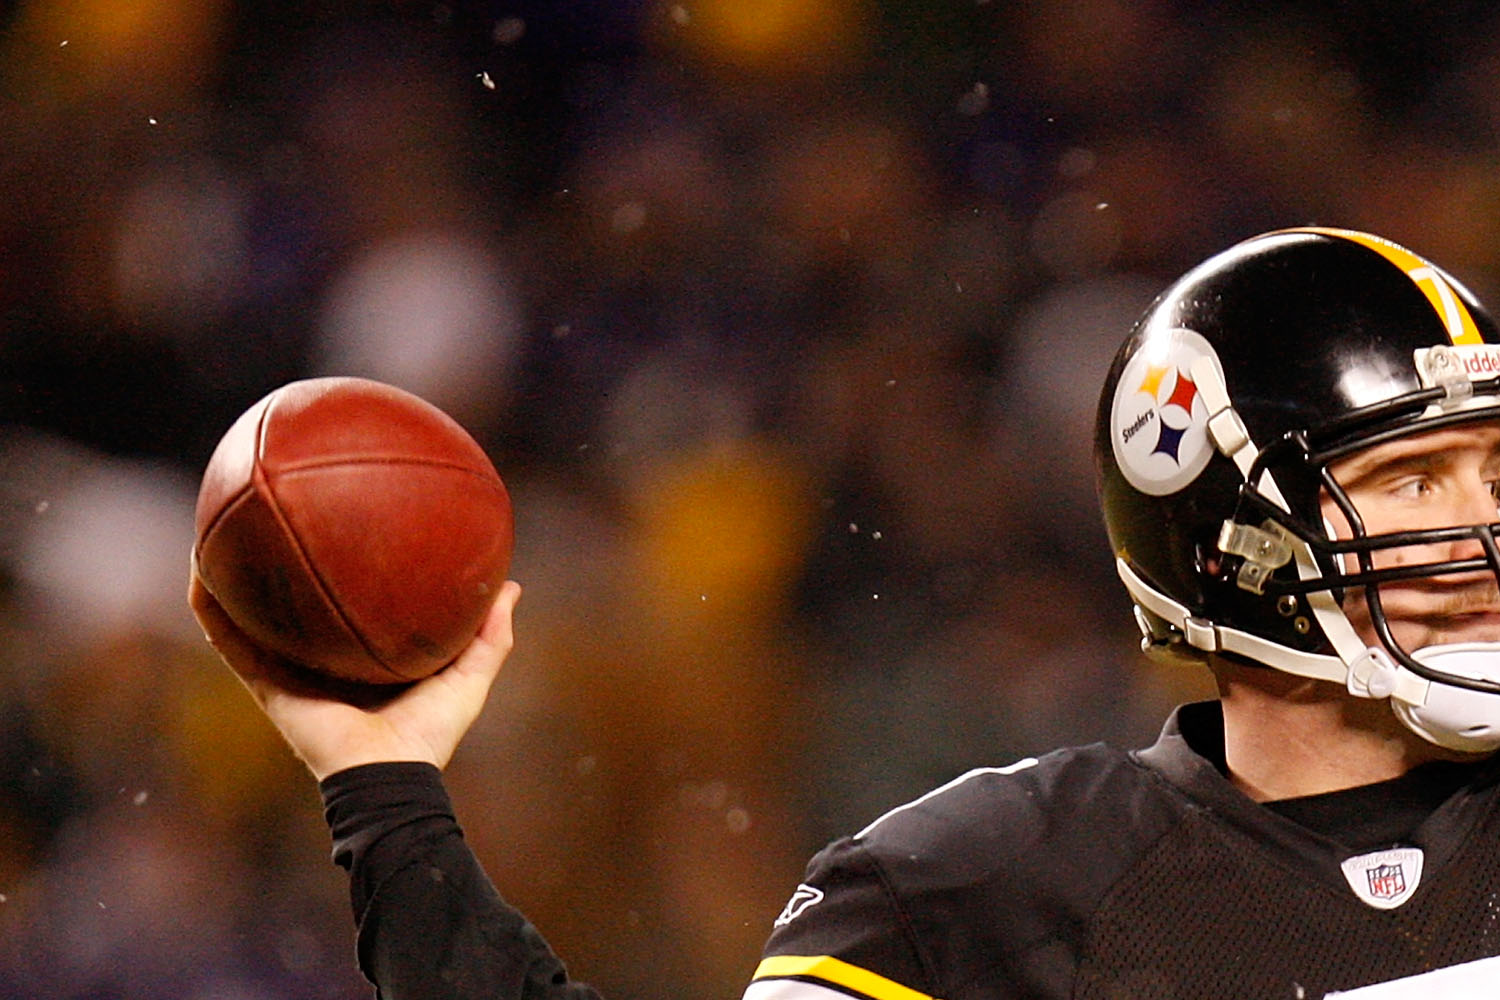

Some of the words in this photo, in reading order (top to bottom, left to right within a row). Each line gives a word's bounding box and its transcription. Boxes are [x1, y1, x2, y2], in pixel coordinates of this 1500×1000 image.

[1408, 267, 1464, 338] 7
[1122, 408, 1154, 444] Steelers
[1371, 876, 1405, 895] NFL
